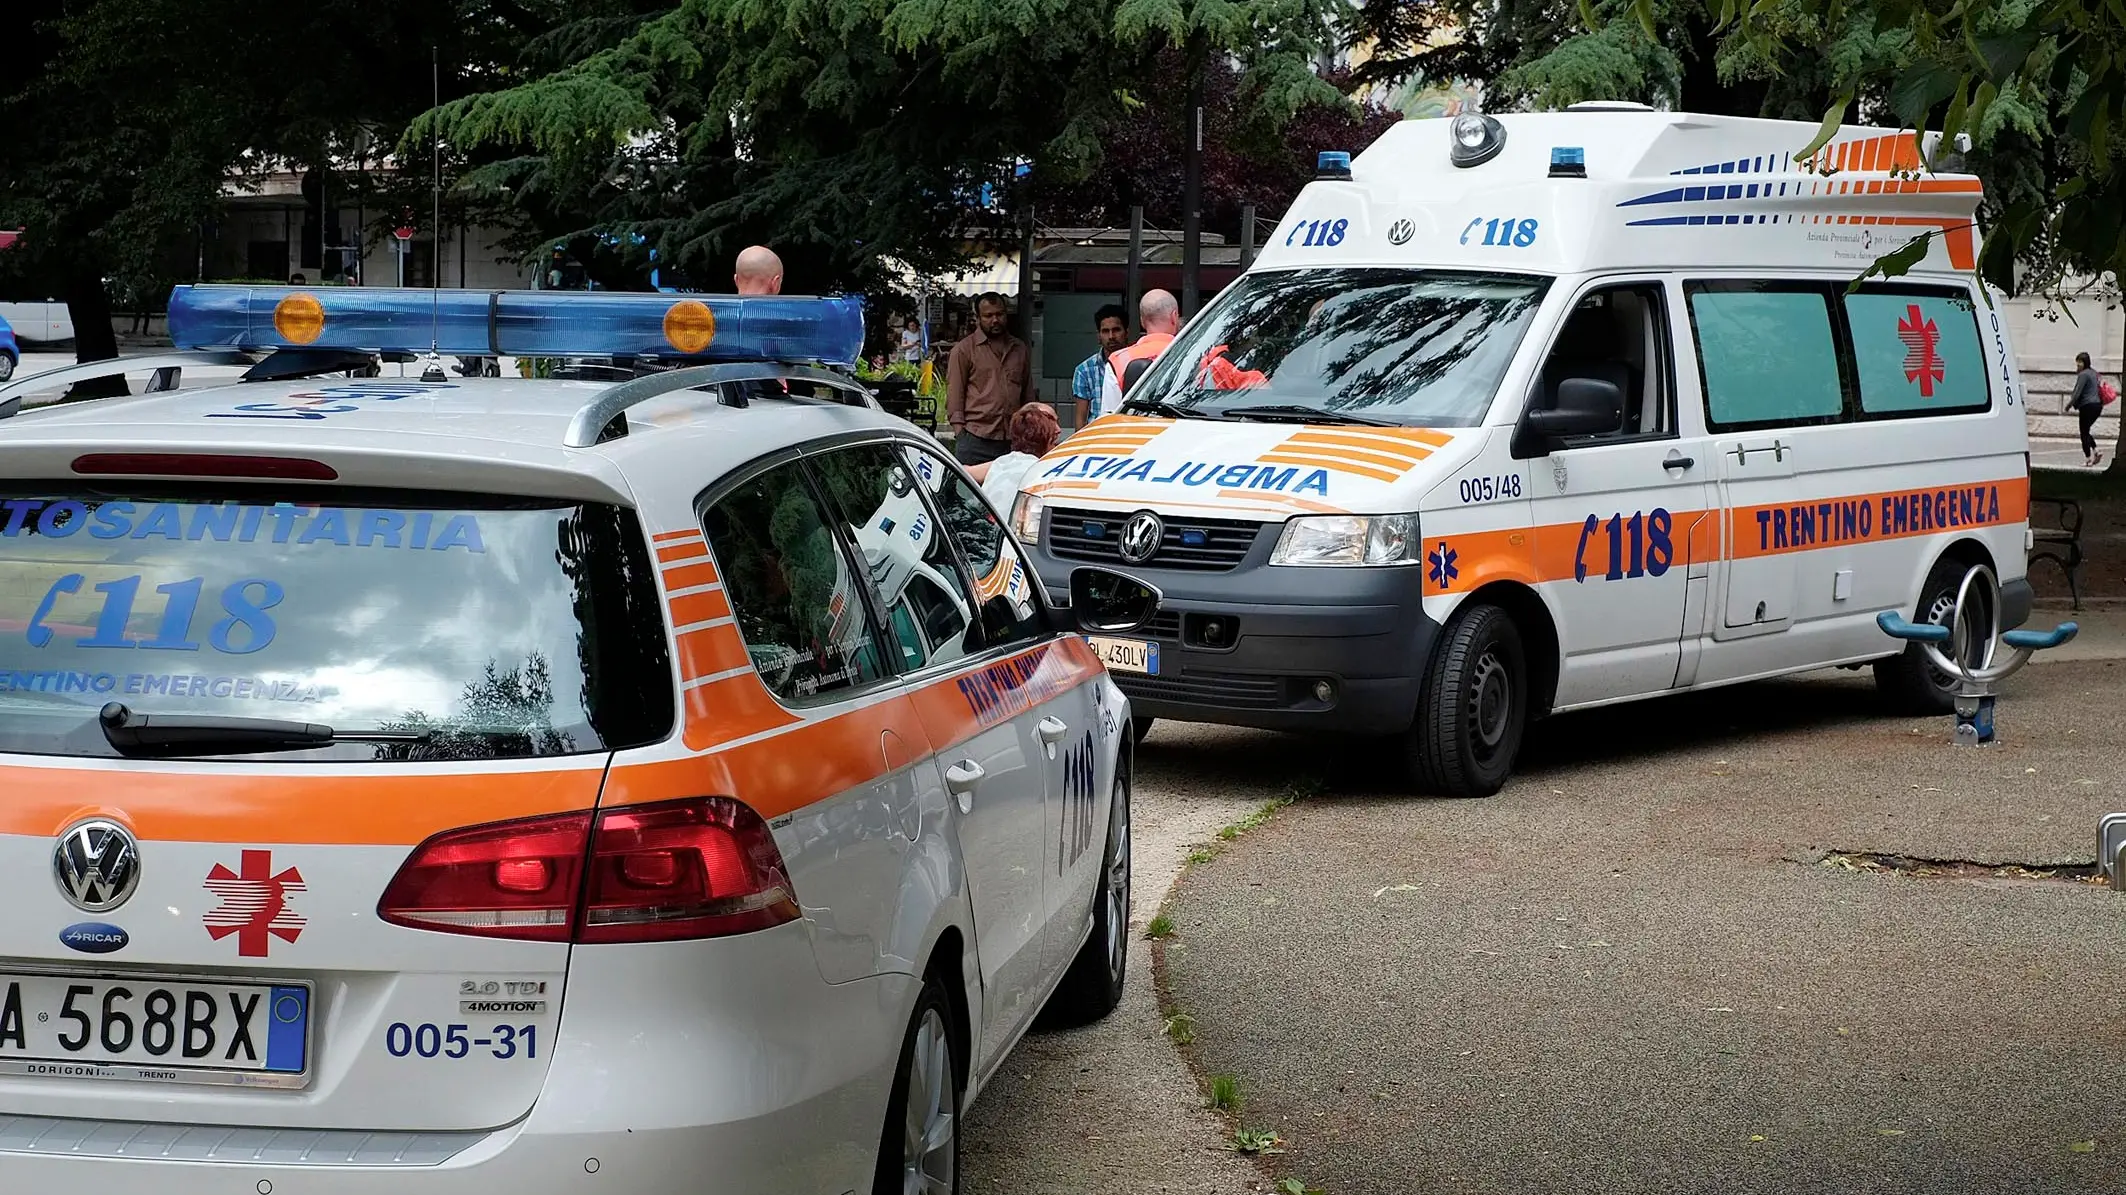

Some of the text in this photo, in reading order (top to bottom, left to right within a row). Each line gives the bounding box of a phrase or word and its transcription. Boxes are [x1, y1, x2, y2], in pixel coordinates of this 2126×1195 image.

[1302, 218, 1349, 247] 118
[1481, 217, 1539, 248] 118
[1986, 292, 2013, 406] 05/48
[1459, 473, 1522, 504] 005/48
[1756, 486, 2000, 550] TRENTINO EMERGENZA
[1605, 507, 1674, 581] 118
[76, 574, 285, 654] 118
[1108, 644, 1147, 667] 430LV
[124, 674, 323, 704] EMERGENZA
[65, 930, 123, 943] ARICAR
[459, 981, 547, 995] 2.0 TDI
[0, 982, 261, 1060] A 568BX
[468, 1002, 537, 1012] 4MOTION
[386, 1022, 536, 1060] 005-31
[138, 1071, 177, 1080] TRENTO
